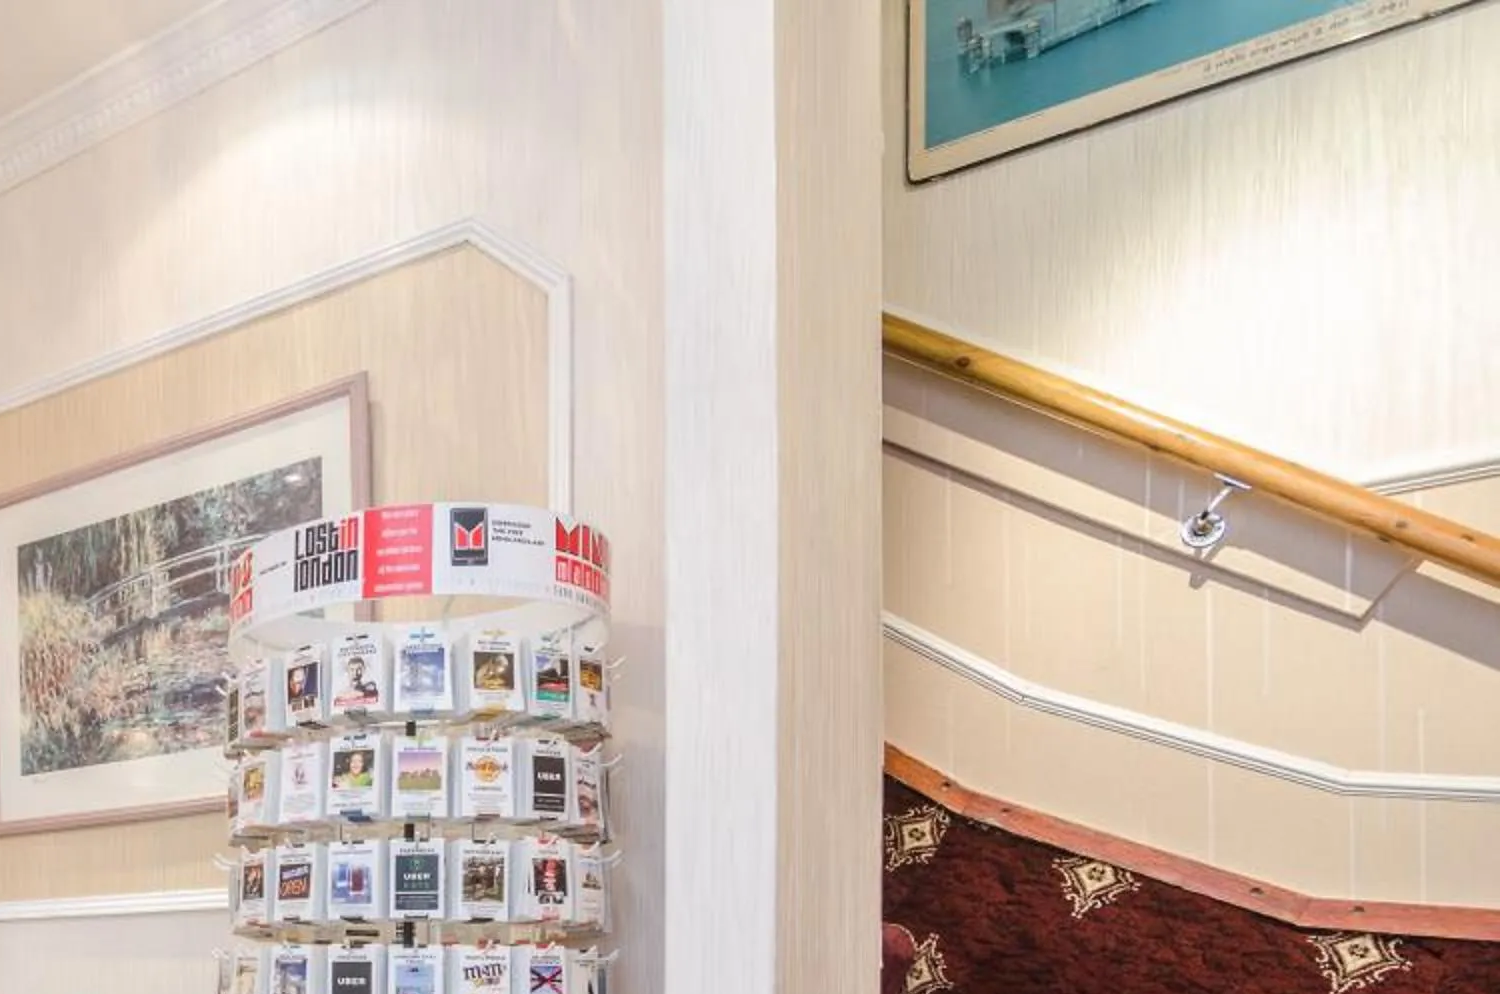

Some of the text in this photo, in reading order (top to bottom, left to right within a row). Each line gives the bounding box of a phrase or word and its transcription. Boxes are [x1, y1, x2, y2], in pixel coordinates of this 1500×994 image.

[340, 517, 359, 548] in
[537, 771, 561, 782] UBER
[402, 872, 431, 881] UBER
[337, 976, 367, 986] UBER
